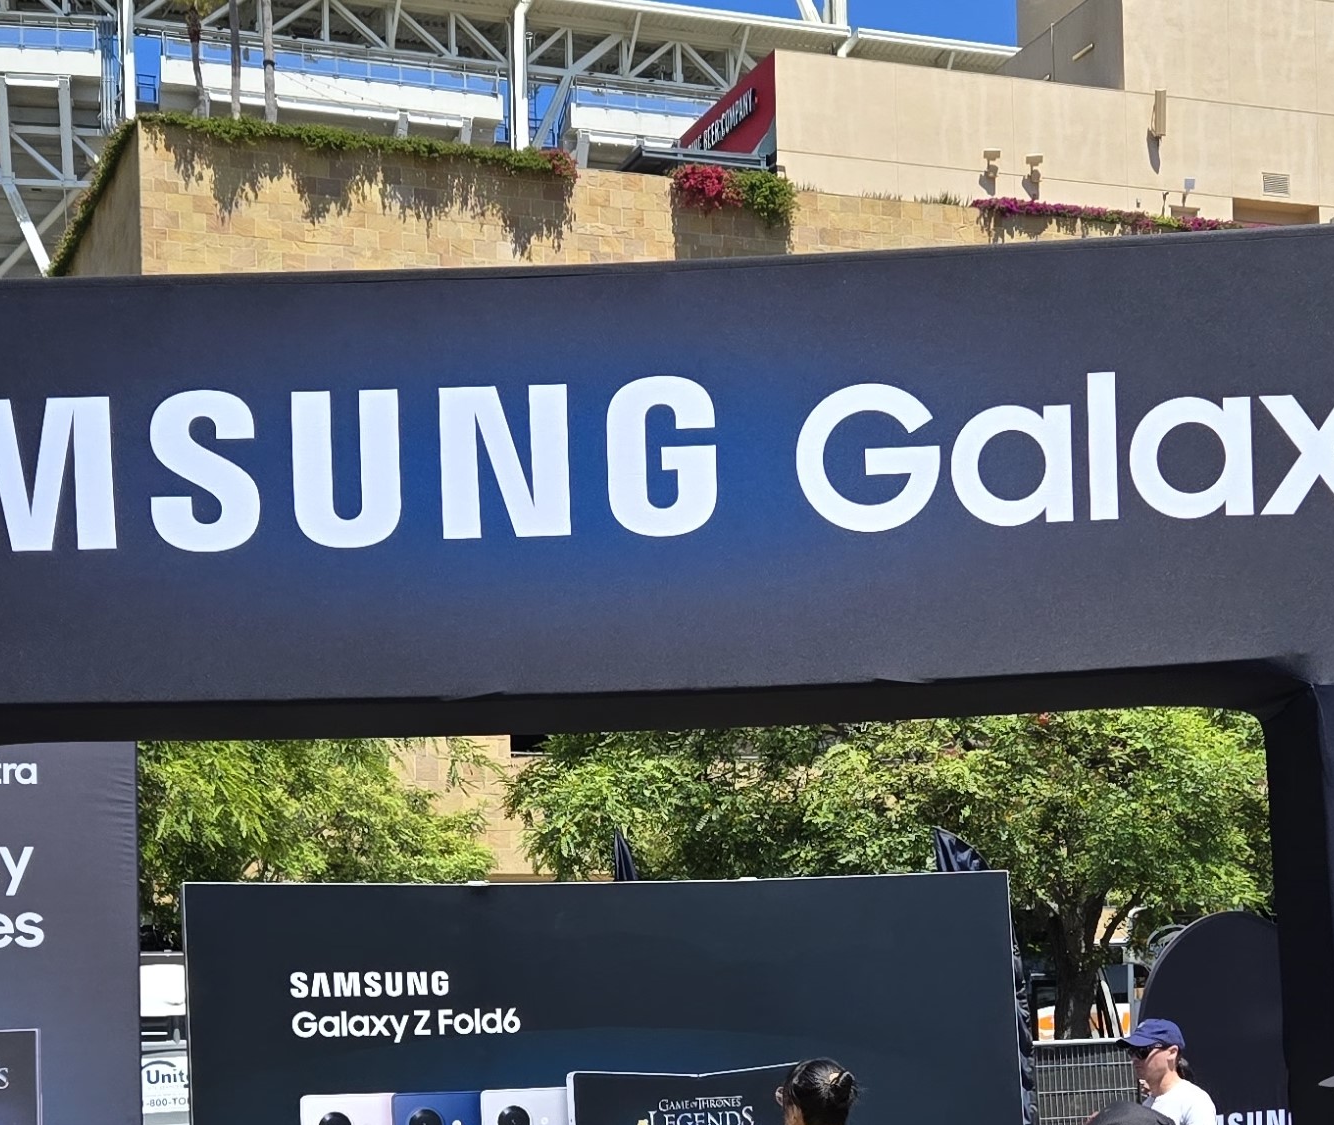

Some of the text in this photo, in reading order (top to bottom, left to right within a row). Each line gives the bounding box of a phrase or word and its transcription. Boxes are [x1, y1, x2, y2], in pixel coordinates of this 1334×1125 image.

[290, 970, 450, 999] SAMSUNG
[291, 1006, 521, 1043] Galaxy Z Fold6
[146, 1068, 189, 1085] Unit
[658, 1098, 690, 1112] GAME
[695, 1095, 743, 1110] THRONES
